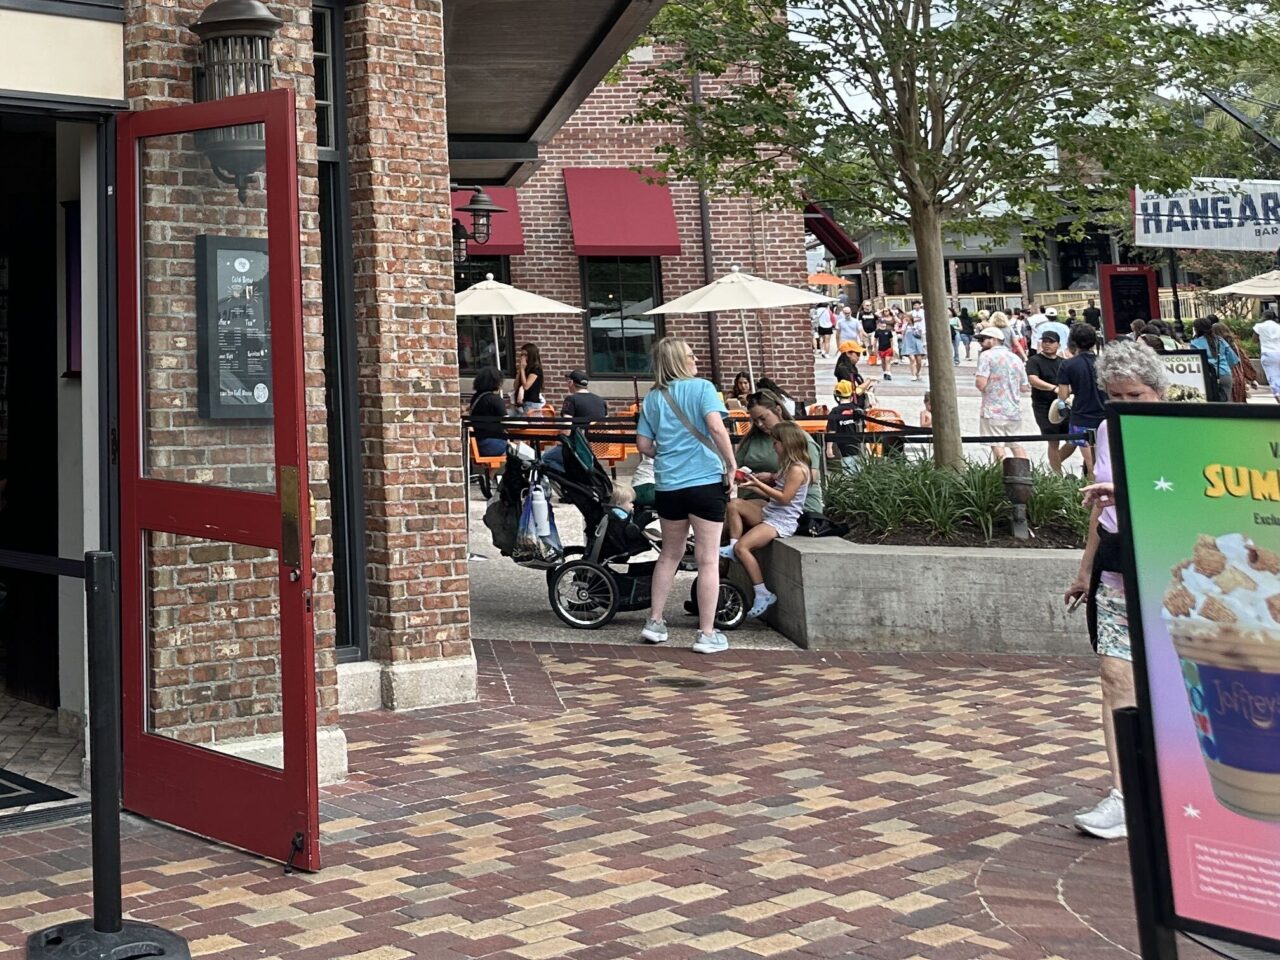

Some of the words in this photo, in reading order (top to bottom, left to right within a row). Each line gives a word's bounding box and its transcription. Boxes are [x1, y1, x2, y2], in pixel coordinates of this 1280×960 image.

[1140, 192, 1280, 234] HANGAR
[1255, 227, 1278, 237] BAR
[1165, 363, 1201, 374] NOLI
[1203, 463, 1280, 502] SUM
